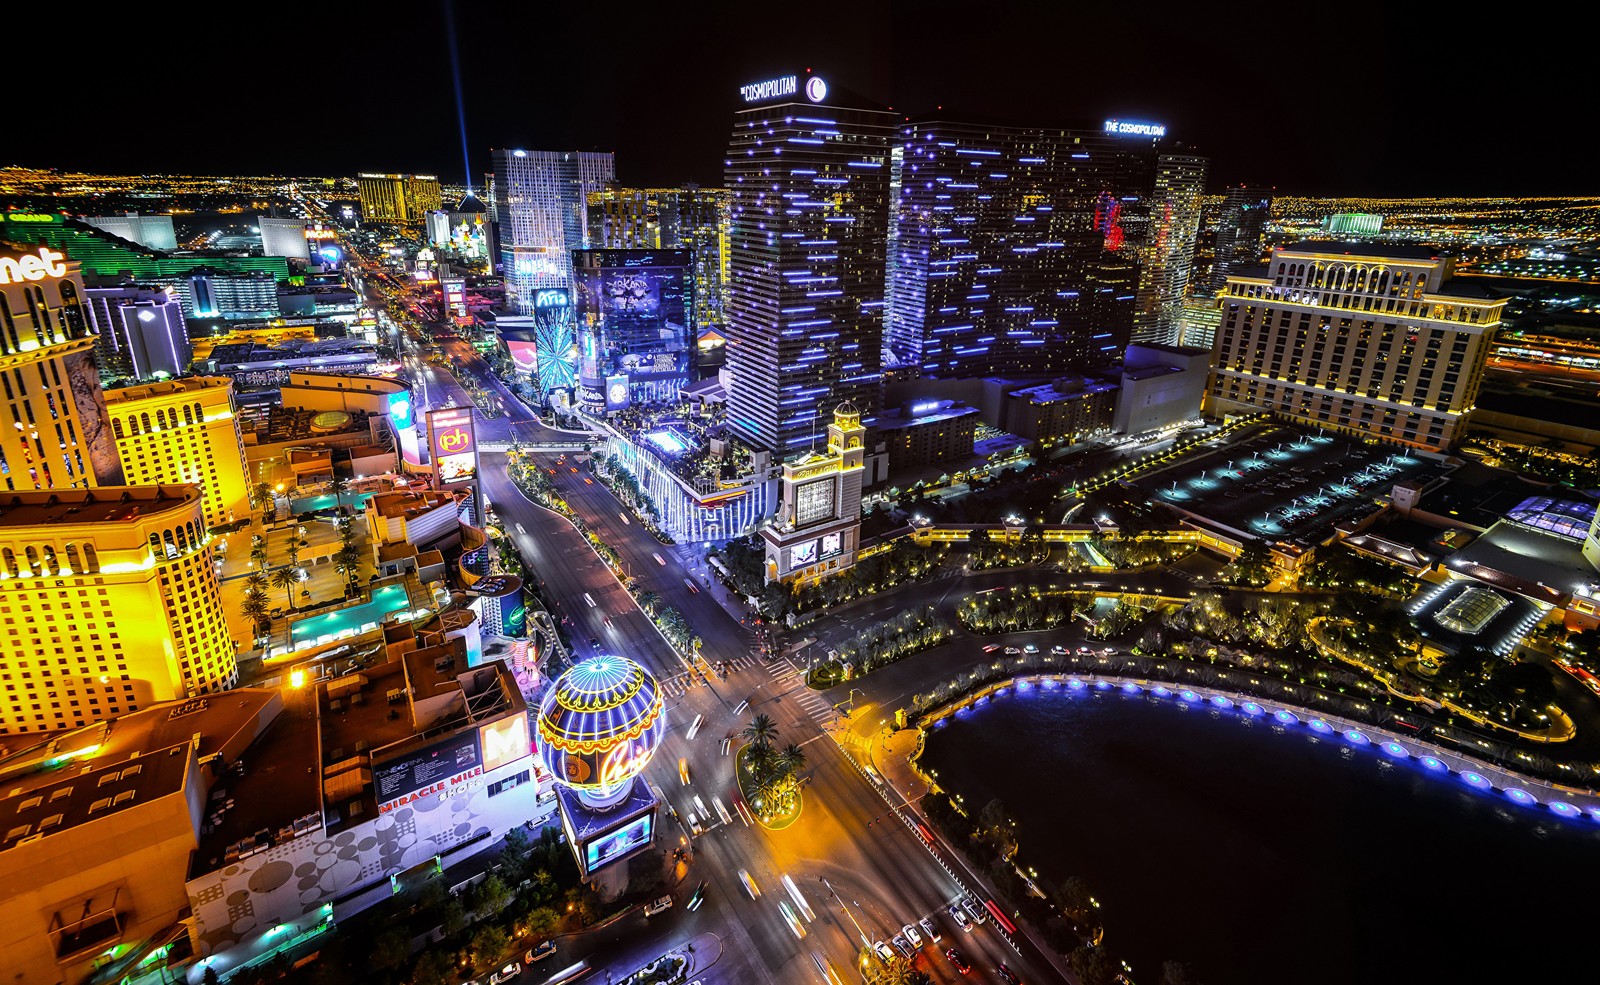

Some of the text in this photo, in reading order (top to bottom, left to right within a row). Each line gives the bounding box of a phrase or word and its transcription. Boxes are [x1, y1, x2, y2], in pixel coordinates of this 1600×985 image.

[745, 75, 797, 101] COSMOPOLITAN
[1105, 121, 1165, 136] THE COSMOPOLITAN
[536, 290, 568, 307] Aria
[443, 428, 469, 450] ph
[379, 781, 446, 814] MIRACLE
[450, 767, 481, 786] MILE
[438, 779, 482, 802] SHOPS
